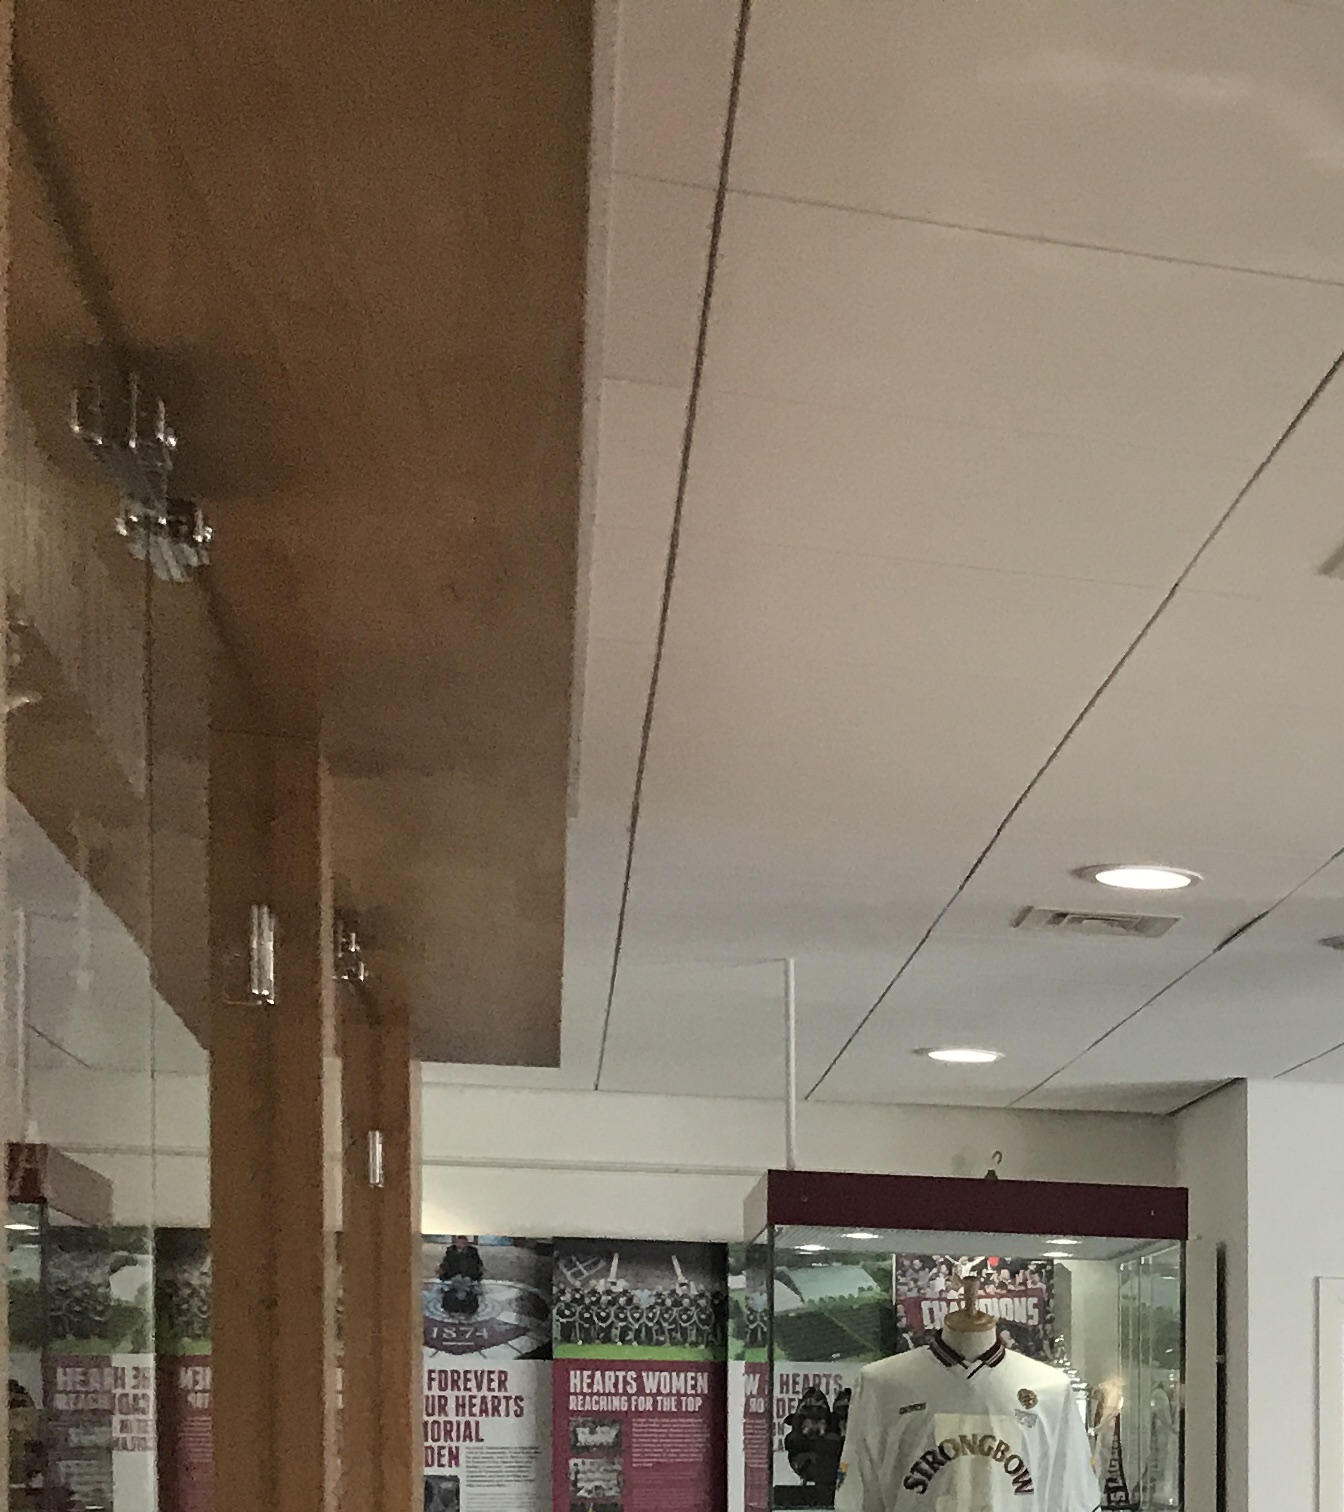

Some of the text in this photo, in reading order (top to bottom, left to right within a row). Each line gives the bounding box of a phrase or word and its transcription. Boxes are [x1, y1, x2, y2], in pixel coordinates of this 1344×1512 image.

[921, 1297, 1039, 1330] CHPIONS
[431, 1326, 489, 1340] 1874
[427, 1369, 508, 1393] FOREVER
[569, 1370, 709, 1394] HEARTS WOMEN
[424, 1394, 525, 1418] UR HEARTS
[569, 1395, 702, 1412] REACHING FOR THE TOP
[424, 1446, 460, 1468] DEN
[903, 1433, 1034, 1496] STRONGBOW
